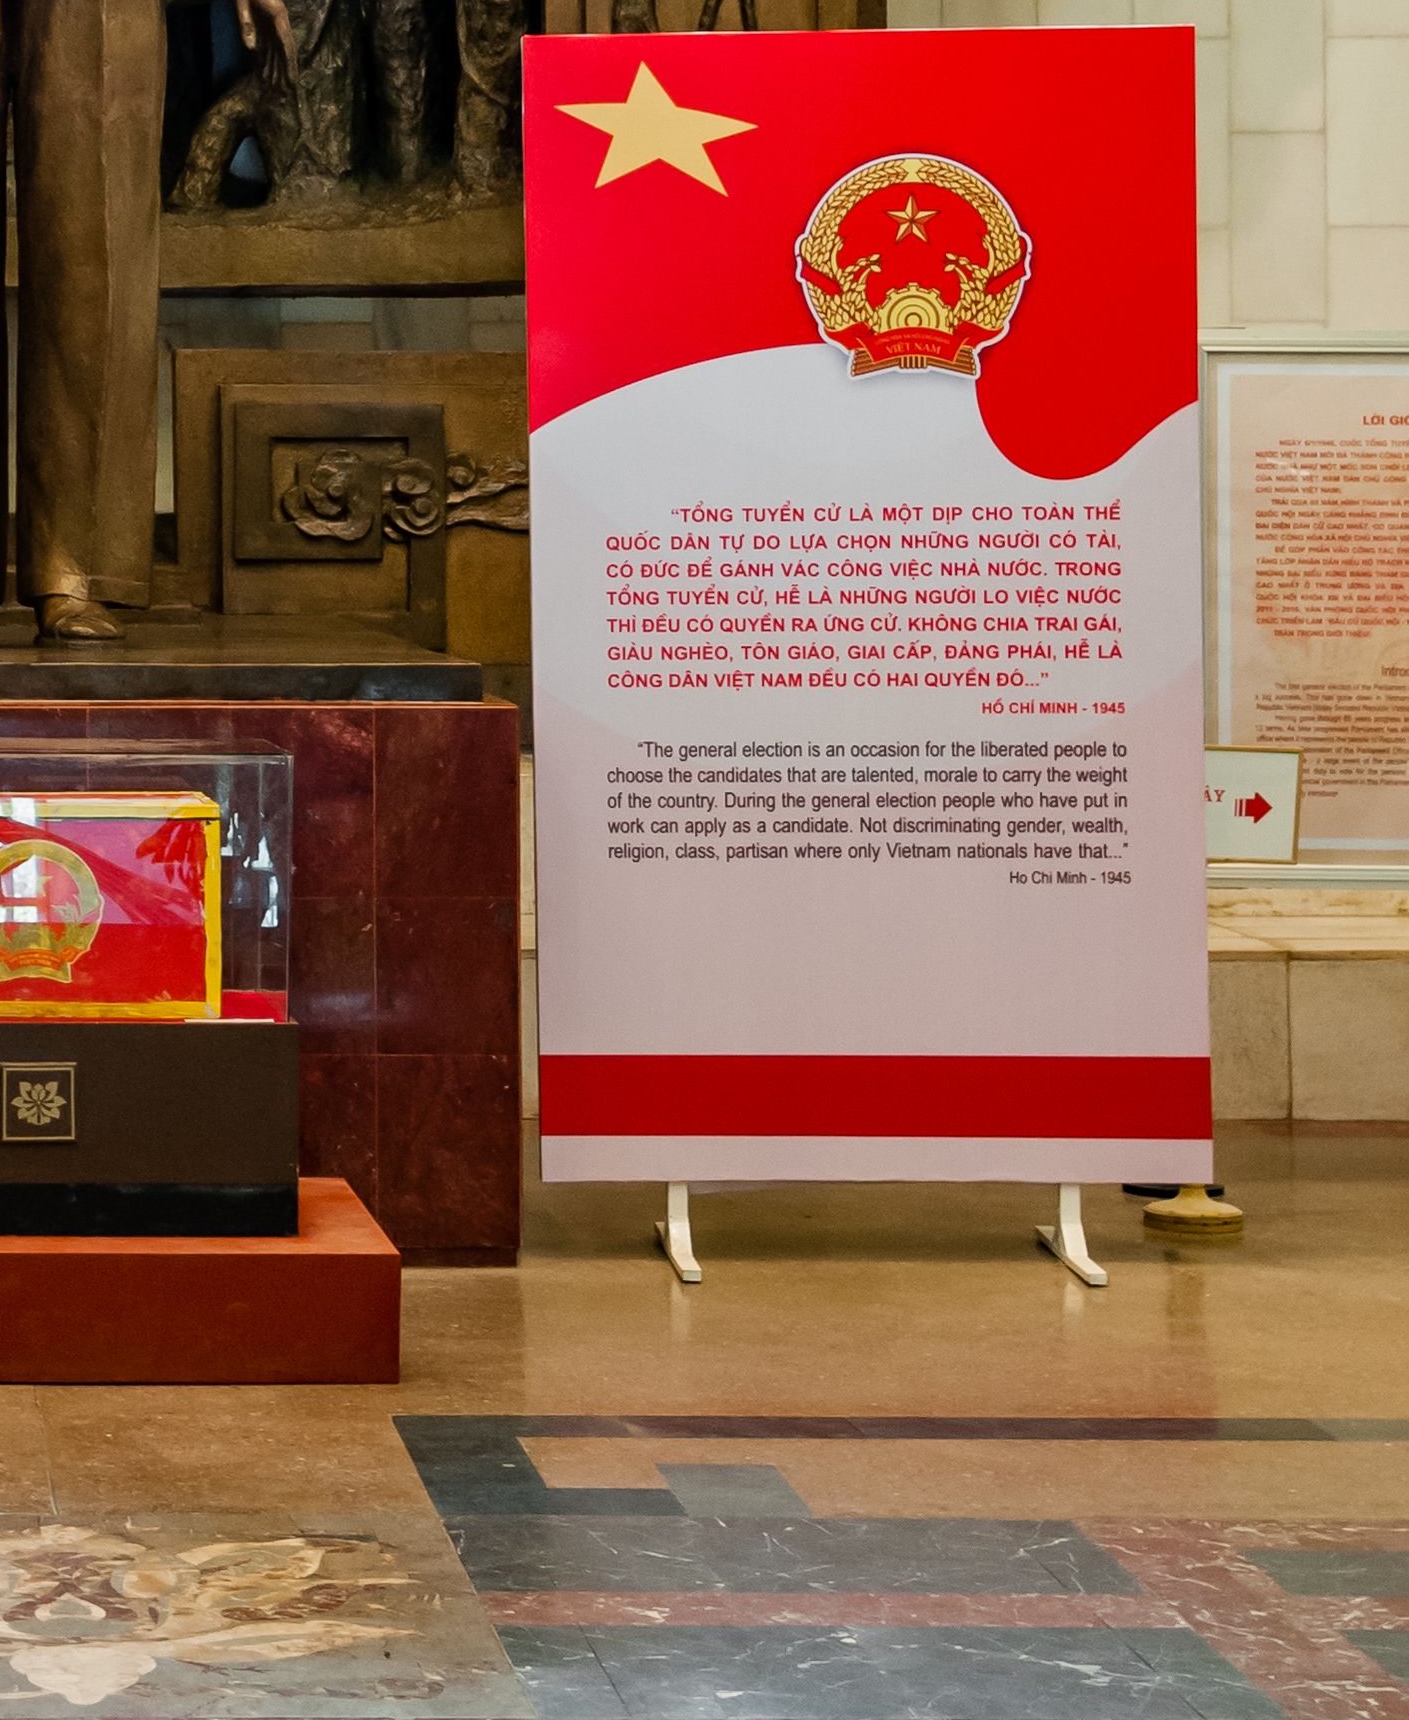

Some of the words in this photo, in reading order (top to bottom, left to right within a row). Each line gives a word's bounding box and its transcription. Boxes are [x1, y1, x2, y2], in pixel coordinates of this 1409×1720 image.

[741, 499, 805, 523] TUYỂN
[813, 502, 842, 523] CỬ
[849, 502, 874, 522] LÀ
[882, 502, 924, 525] MỘT
[932, 506, 963, 525] DỊP
[971, 506, 1014, 522] CHO
[1020, 501, 1075, 522] TOÀN
[1082, 498, 1121, 521] THỂ
[605, 529, 661, 552] QUỐC
[670, 531, 710, 551] DÂN
[718, 533, 746, 554] TỰ
[753, 534, 781, 550] DO
[789, 533, 828, 554] LỰA
[836, 534, 891, 553] CHỌN
[900, 530, 970, 549] NHỮNG
[978, 529, 1040, 549] NGƯỜI
[1048, 529, 1077, 549] CÓ
[1085, 528, 1122, 551] TÀI,
[605, 559, 634, 579] CÓ
[639, 559, 680, 579] ĐỨC
[686, 555, 713, 578] ĐỂ
[719, 559, 774, 578] GÁNH
[780, 558, 820, 578] VÁC
[826, 558, 883, 578] CÔNG
[889, 558, 933, 581] VIỆC
[940, 557, 981, 577] NHÀ
[987, 557, 1048, 577] NƯỚC.
[1054, 561, 1122, 577] TRONG
[686, 613, 714, 633] CÓ
[791, 617, 819, 633] RA
[823, 613, 865, 633] ỨNG
[869, 611, 902, 633] CỬ.
[907, 613, 978, 632] KHÔNG
[982, 616, 1029, 632] CHIA
[1033, 616, 1078, 632] TRAI
[1083, 612, 1122, 634] GÁI,
[607, 669, 663, 689] CÔNG
[668, 669, 709, 688] DÂN
[713, 669, 756, 692] VIỆT
[761, 672, 803, 688] NAM
[853, 668, 882, 688] CÓ
[886, 672, 919, 687] HAI
[1008, 698, 1035, 715] CHÍ
[1038, 701, 1078, 715] MINH
[1091, 701, 1126, 715] 1945
[678, 741, 737, 763] general
[741, 740, 803, 758] election
[807, 740, 821, 758] is
[825, 744, 845, 758] an
[850, 740, 920, 758] occasion
[924, 739, 947, 758] for
[950, 740, 976, 758] the
[980, 740, 1049, 758] liberated
[1053, 740, 1108, 762] people
[1111, 740, 1128, 758] to
[606, 766, 664, 784] choose
[667, 766, 693, 784] the
[696, 766, 783, 784] candidates
[786, 766, 817, 783] that
[820, 769, 847, 783] are
[851, 765, 919, 785] talented,
[923, 765, 979, 783] morale
[982, 766, 998, 783] to
[1001, 769, 1043, 787] carry
[1046, 765, 1072, 783] the
[1075, 765, 1129, 788] weight
[608, 842, 669, 863] religion,
[674, 842, 720, 861] class,
[725, 842, 789, 863] partisan
[793, 841, 843, 859] where
[847, 842, 882, 863] only
[885, 841, 951, 859] Vietnam
[956, 841, 1028, 860] nationals
[1033, 842, 1073, 859] have
[1009, 870, 1028, 885] Ho
[1030, 870, 1053, 885] Chi
[1056, 870, 1088, 885] Minh
[1100, 870, 1132, 885] 1945
